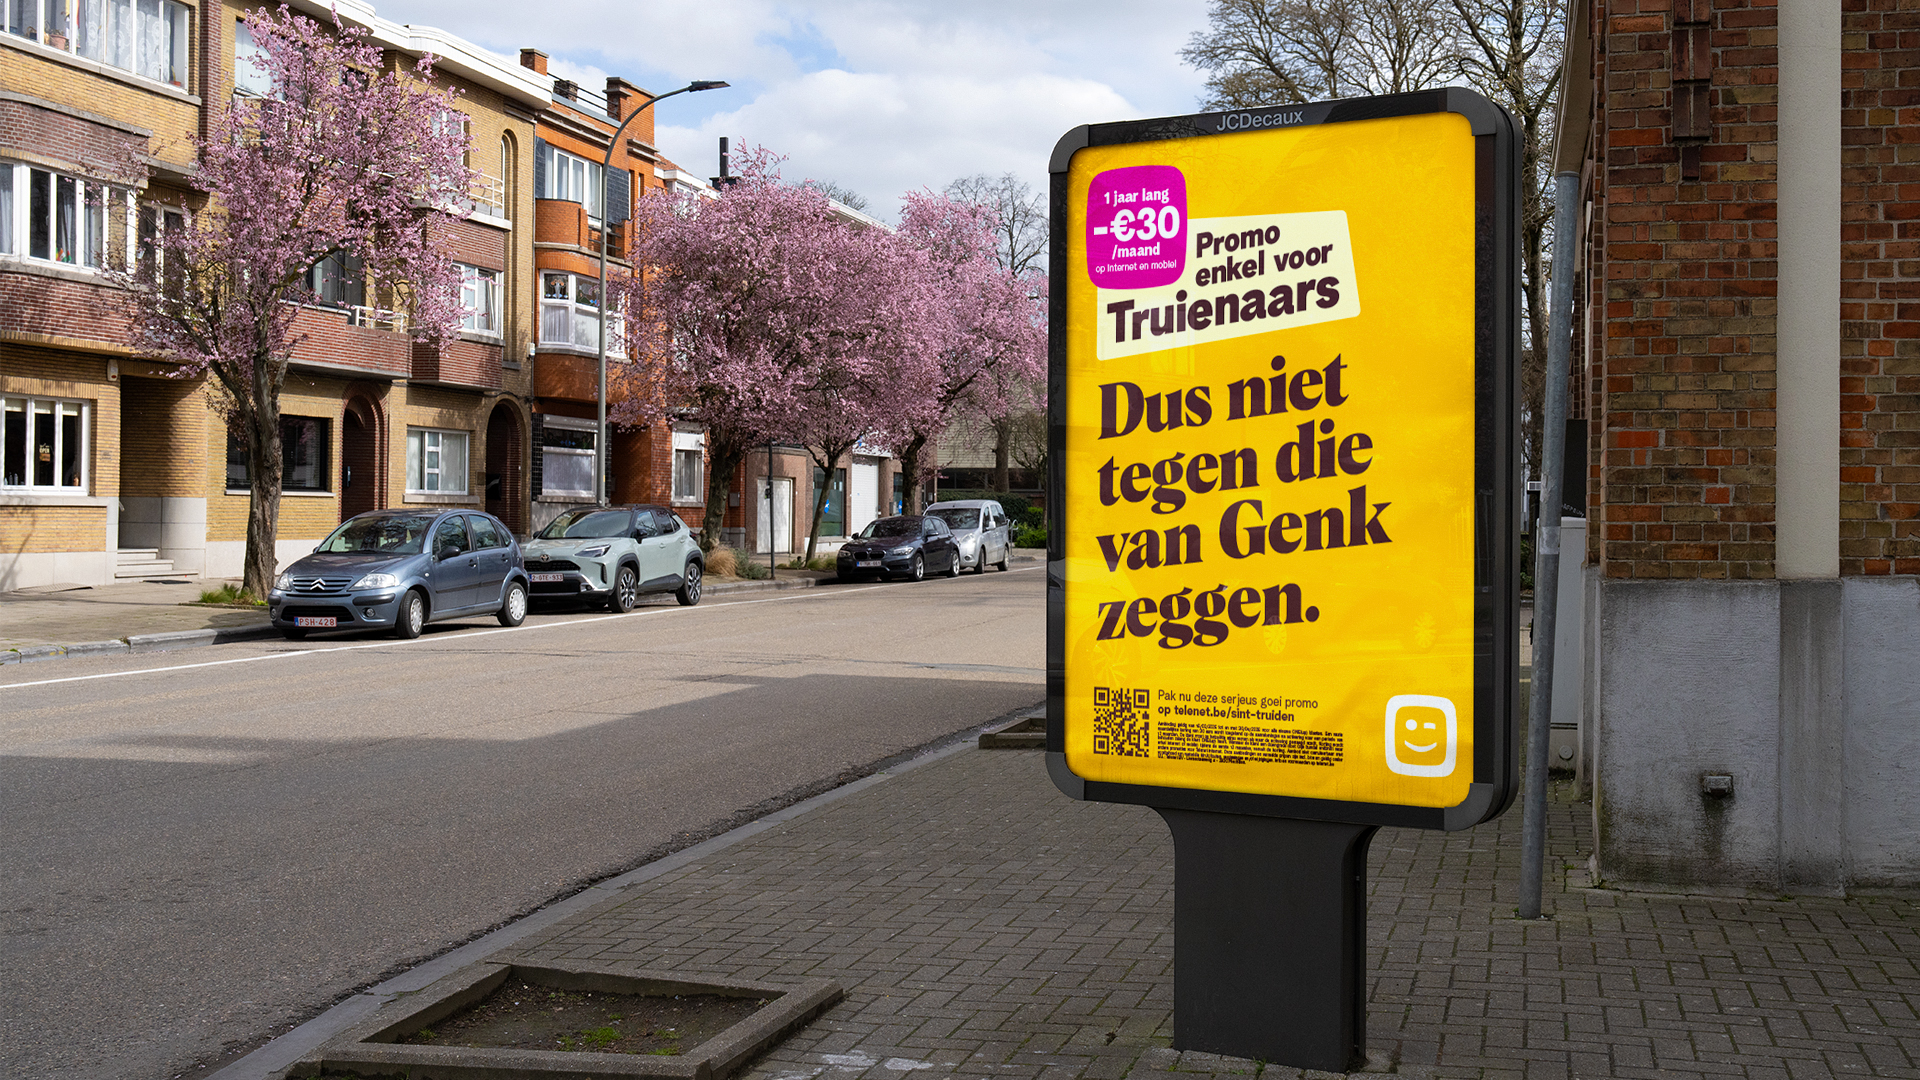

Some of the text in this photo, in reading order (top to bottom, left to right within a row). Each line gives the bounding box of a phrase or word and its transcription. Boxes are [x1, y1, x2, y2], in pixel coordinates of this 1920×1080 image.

[1216, 110, 1303, 131] JCDecaux
[1103, 187, 1170, 207] 1 jaar lang
[1093, 205, 1180, 242] -€30
[1111, 241, 1160, 260] /maand
[1196, 225, 1281, 259] Promo
[1095, 265, 1106, 274] op
[1139, 262, 1149, 271] en
[1151, 259, 1177, 270] mobiel
[1195, 243, 1334, 287] enkel voor
[1106, 276, 1340, 344] Truienaars
[1097, 353, 1350, 441] Dus niet
[1097, 418, 1374, 515] tegen die
[1096, 484, 1393, 573] van Genk
[1096, 582, 1320, 650] zeggen.
[1158, 689, 1319, 710] Pak nu deze serjeus goei promo
[1158, 704, 1295, 722] op telenet.be/sint-truiden
